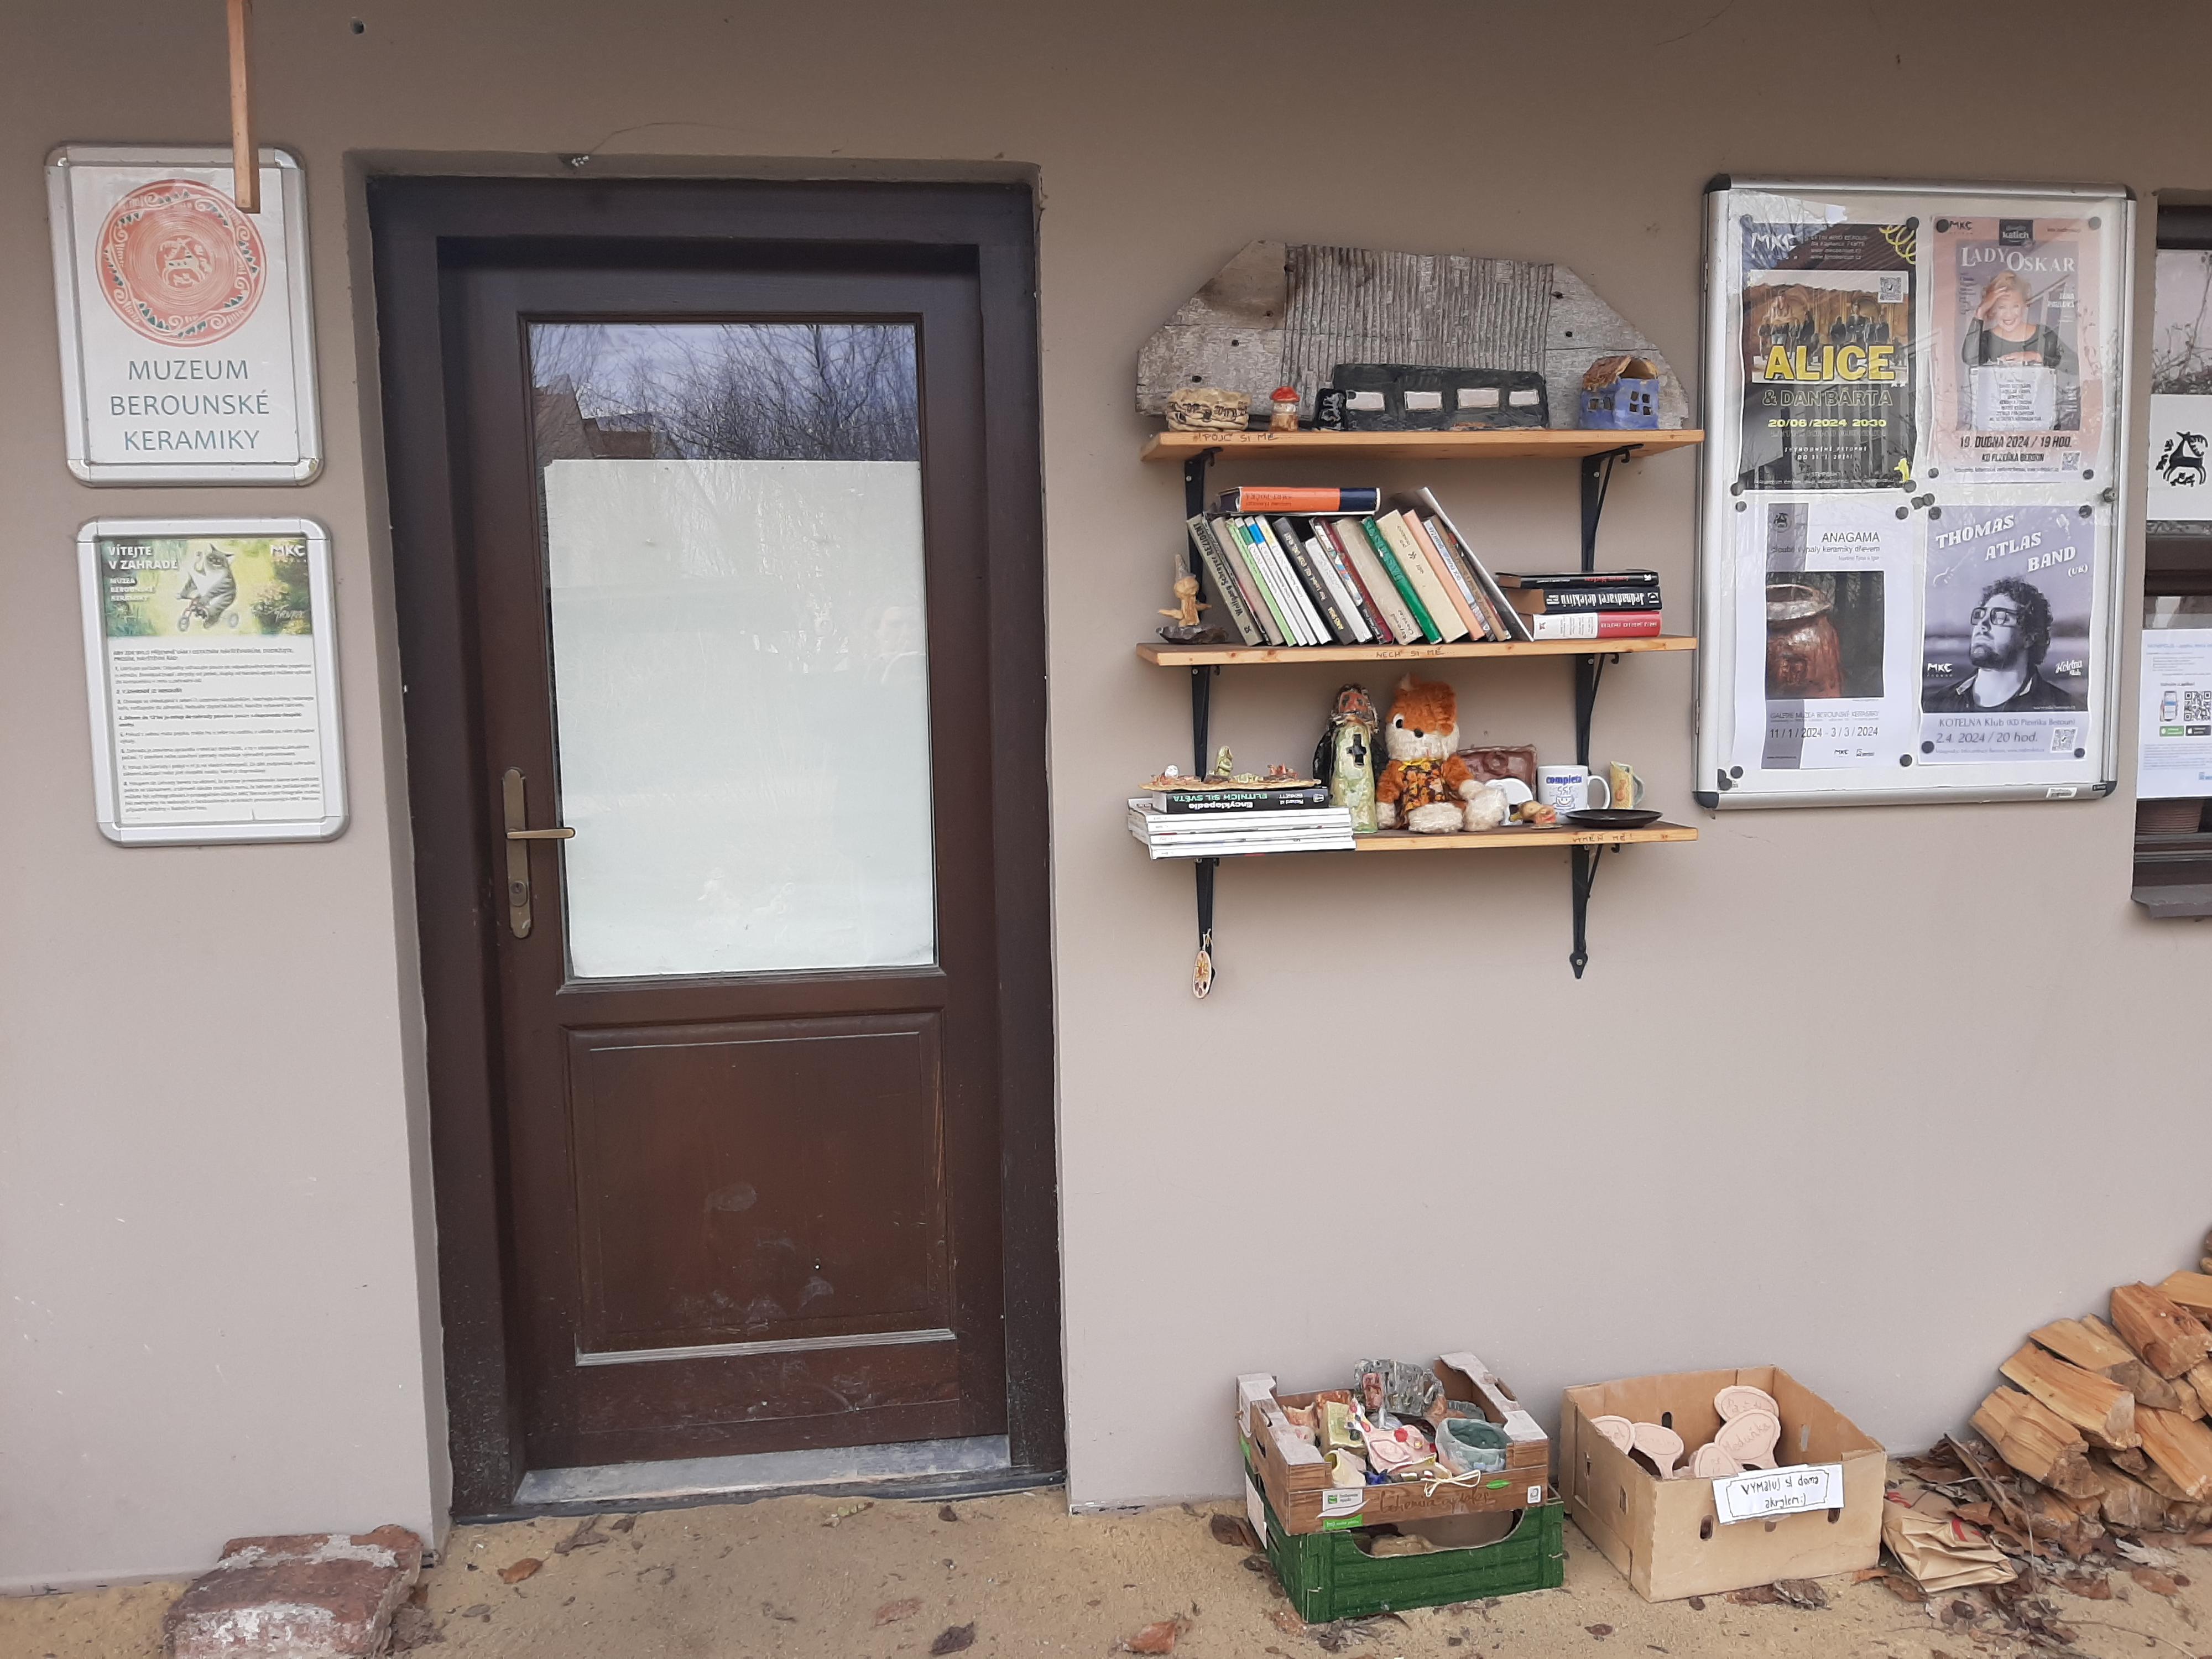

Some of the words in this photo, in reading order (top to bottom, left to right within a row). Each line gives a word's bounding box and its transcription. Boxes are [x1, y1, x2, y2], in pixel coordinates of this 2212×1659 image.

[1752, 233, 1796, 252] MKC
[2006, 252, 2075, 272] OSKAR
[1764, 344, 1895, 380] ALICE
[129, 360, 248, 380] MUZEUM
[111, 389, 269, 415] BEROUNSKÉ
[1762, 390, 1777, 406] &
[1781, 390, 1822, 406] DAN
[1825, 387, 1893, 406] BÁRTA
[1851, 419, 1887, 427] 2030
[124, 430, 259, 450] KERAMIKY
[1240, 434, 1250, 442] SI
[1960, 436, 1972, 447] 19.
[1975, 436, 2004, 447] DUBNA
[2006, 436, 2030, 447] 2024
[2041, 436, 2051, 447] 19
[1192, 521, 1214, 556] REZIDENT
[1822, 532, 1880, 542] ANAGAMA
[1936, 514, 2015, 549] THOMAS
[107, 544, 152, 558] VÍTEJTE
[1985, 532, 2042, 561] ATLAS
[108, 561, 117, 570] V
[2027, 546, 2076, 572] BAND
[1928, 663, 1952, 672] MKC
[1939, 718, 1981, 727] KOTELNA
[1985, 718, 2004, 727] Klub
[1770, 729, 1778, 738] 11
[1788, 729, 1792, 738] 1
[1801, 728, 1823, 738] 2024
[1831, 727, 1837, 737] 3
[1844, 727, 1850, 737] 3
[1857, 726, 1879, 737] 2024
[1958, 733, 1985, 743] 2024
[1996, 732, 2010, 743] 20
[2014, 732, 2038, 742] hod.
[1546, 775, 1582, 785] completa
[1798, 1475, 1819, 1486] doma
